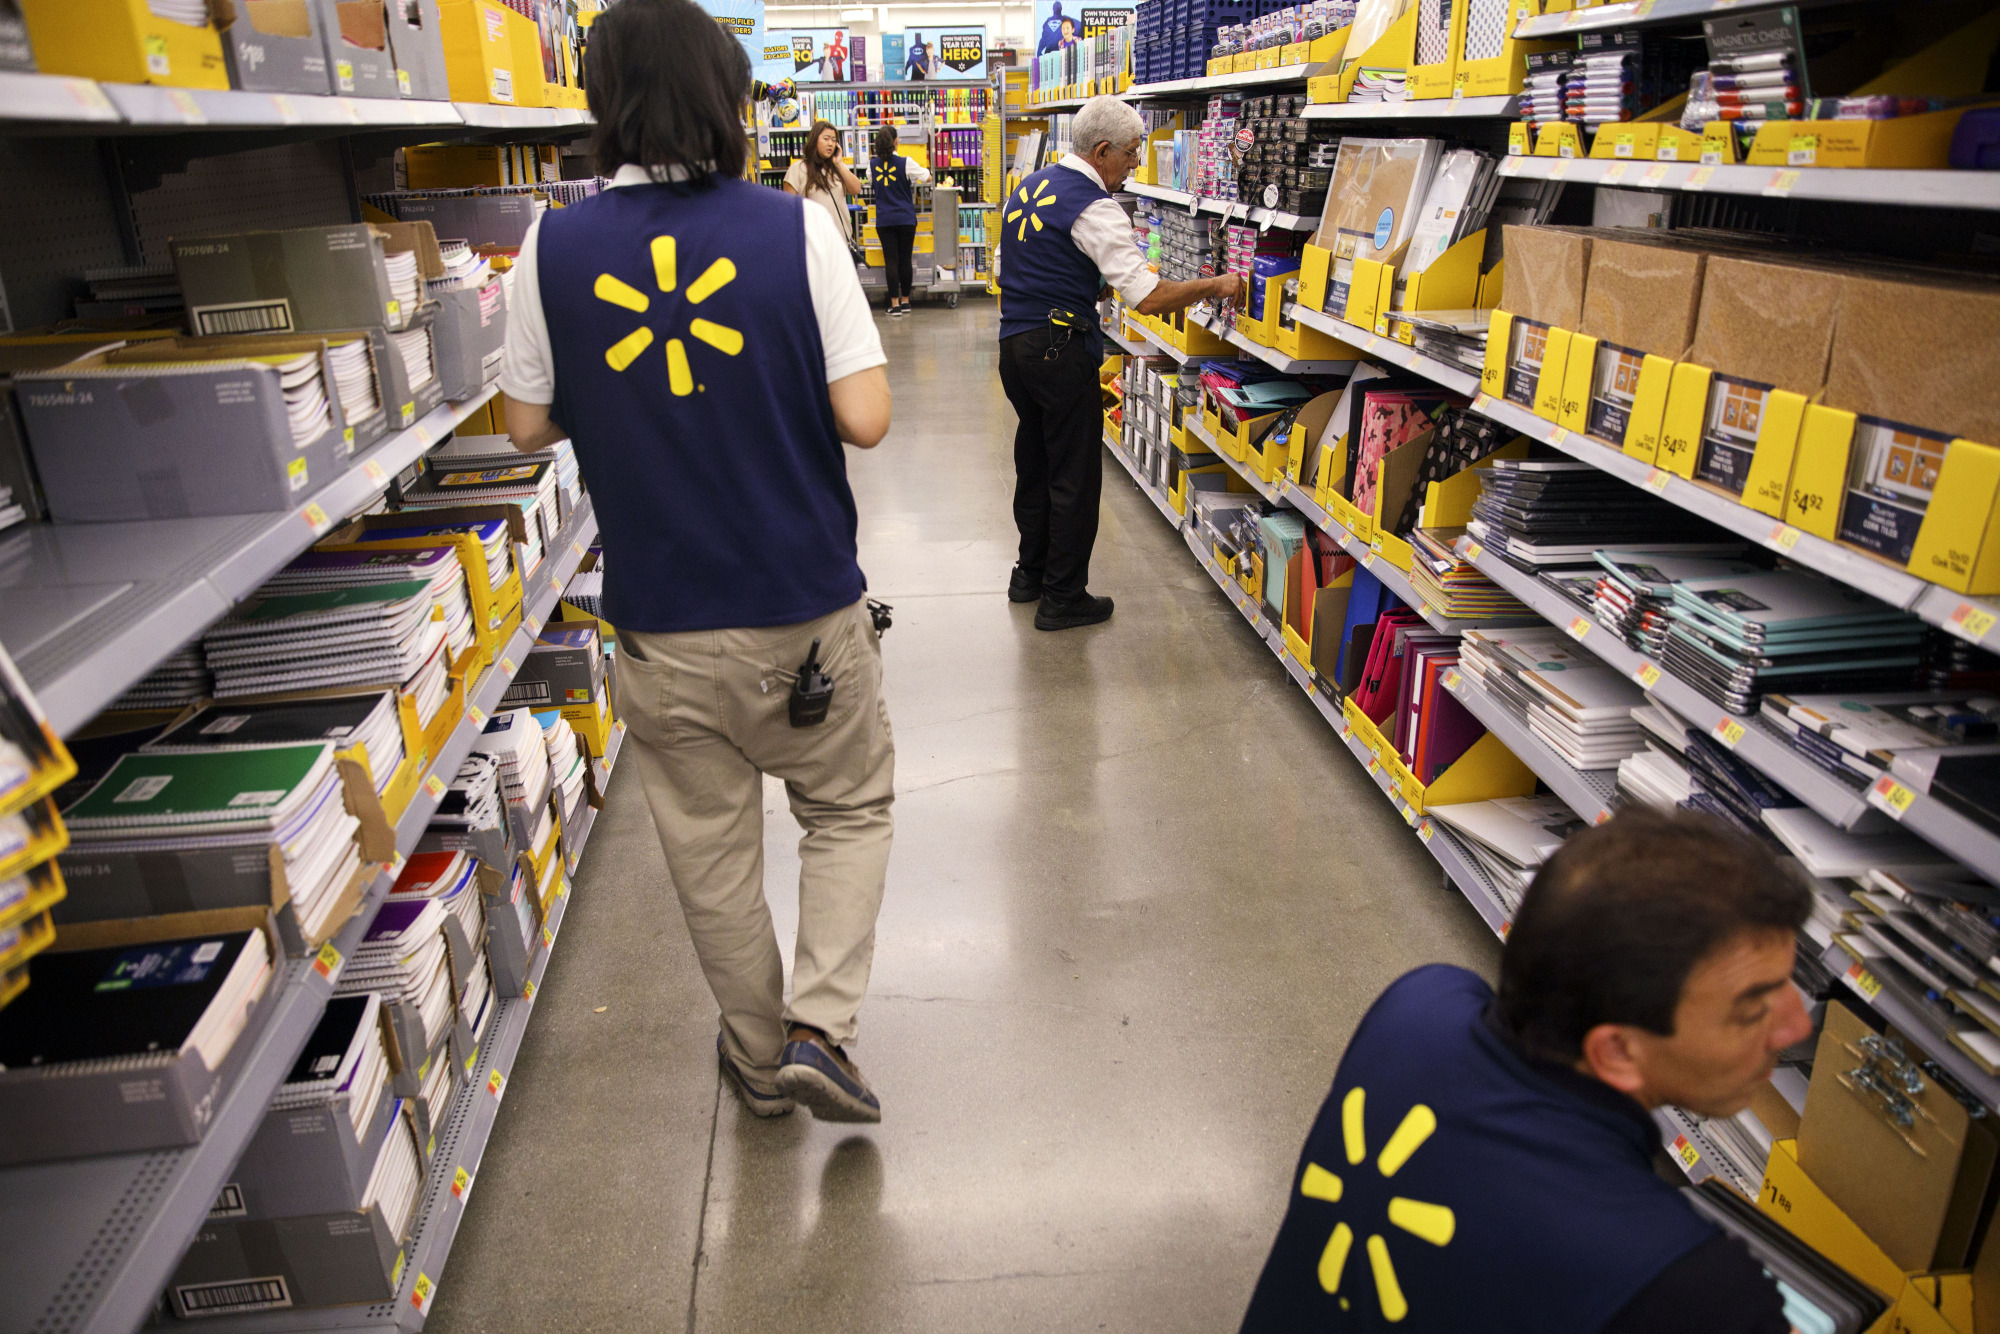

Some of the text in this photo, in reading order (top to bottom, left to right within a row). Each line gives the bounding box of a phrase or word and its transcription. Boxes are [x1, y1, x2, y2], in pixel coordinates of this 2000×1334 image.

[737, 18, 755, 26] FILES
[1084, 18, 1106, 26] YEAR
[1712, 26, 1793, 48] MAGNETIC CHISEL
[772, 52, 791, 60] CARDS
[943, 48, 981, 60] HERO
[1759, 487, 1781, 501] Cork Tiles
[1863, 519, 1898, 539] CORK TILES
[1932, 555, 1966, 576] Cork Tiles
